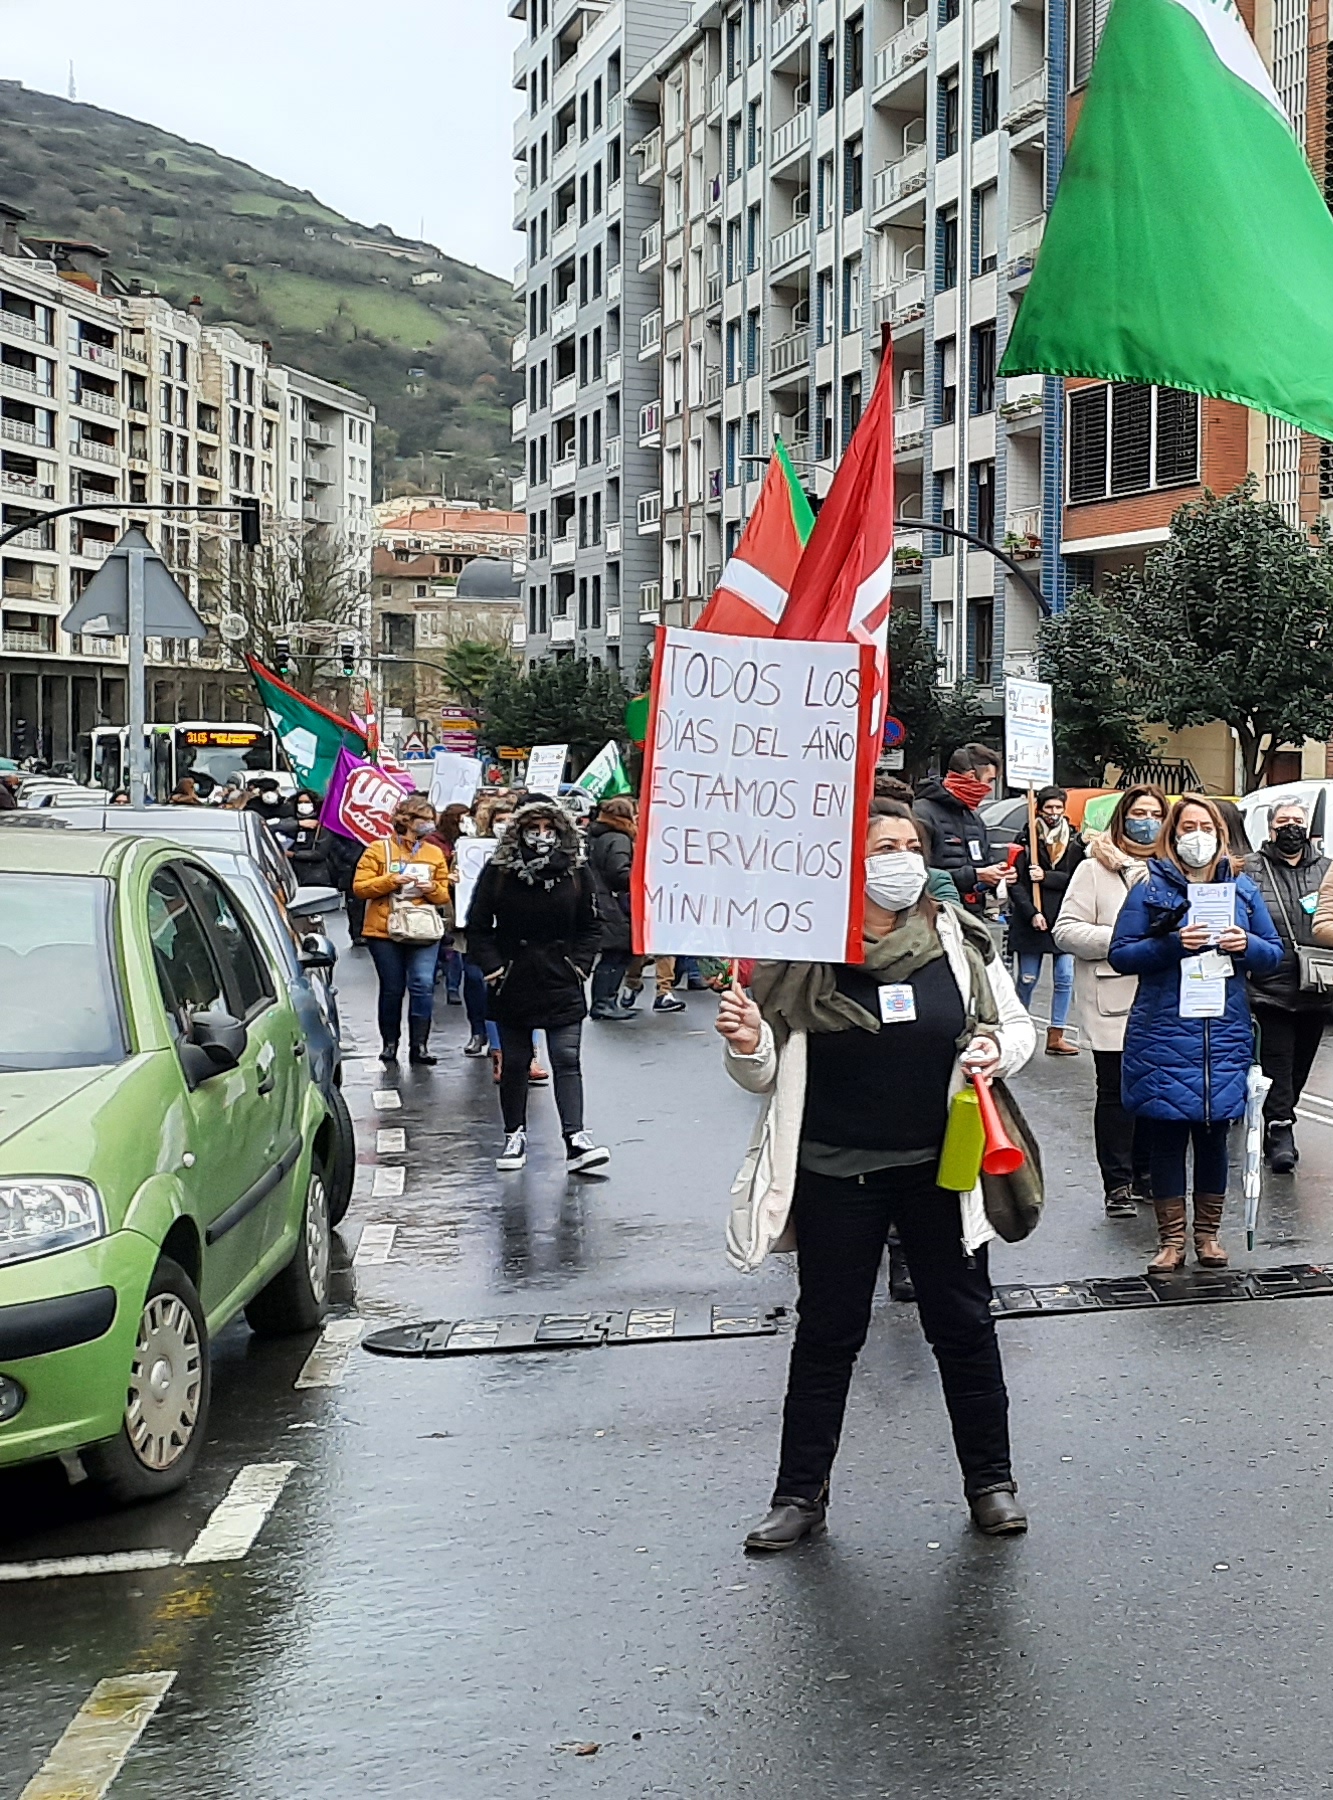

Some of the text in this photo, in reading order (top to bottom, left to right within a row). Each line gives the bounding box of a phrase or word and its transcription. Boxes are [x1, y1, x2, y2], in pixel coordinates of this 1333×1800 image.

[666, 643, 861, 709] TODOS LOS
[656, 709, 855, 762] DÍAS DEL AÑO
[652, 766, 796, 820] ESTAMOS
[812, 783, 847, 818] EN
[661, 825, 844, 880] SERVICIOS
[644, 883, 814, 934] MÍNIMOS
